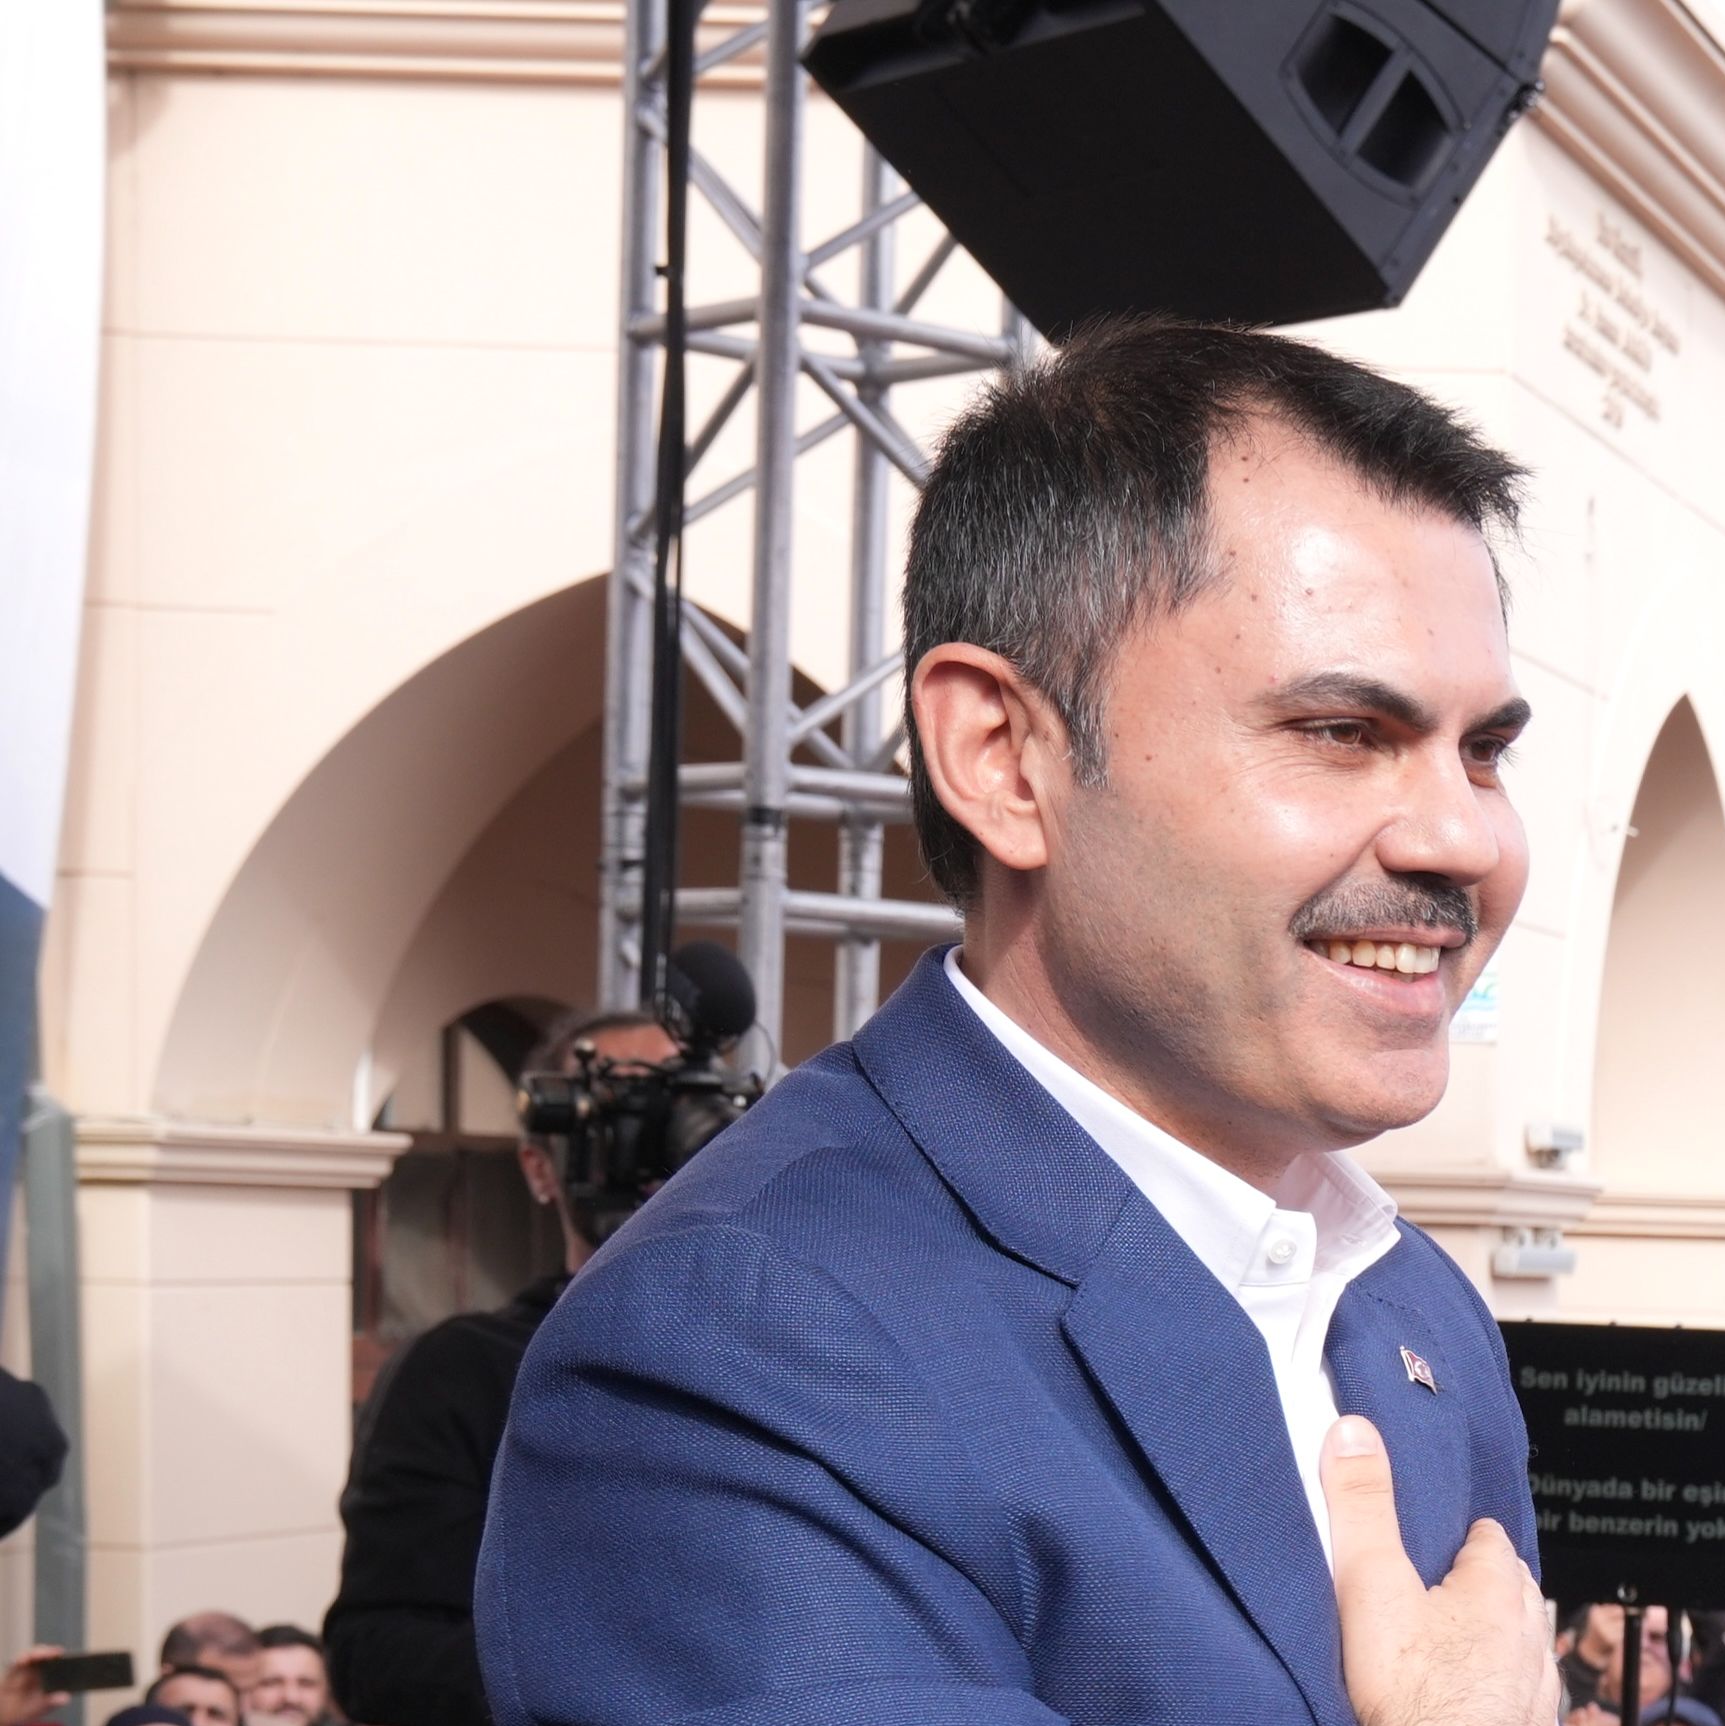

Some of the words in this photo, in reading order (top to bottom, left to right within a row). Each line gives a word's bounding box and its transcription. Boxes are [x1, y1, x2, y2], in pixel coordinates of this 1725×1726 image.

[1519, 1367, 1570, 1390] Sen
[1576, 1368, 1646, 1395] iyinin
[1564, 1404, 1708, 1431] alametisin/
[1641, 1479, 1677, 1501] bir
[1569, 1513, 1679, 1538] benzerin
